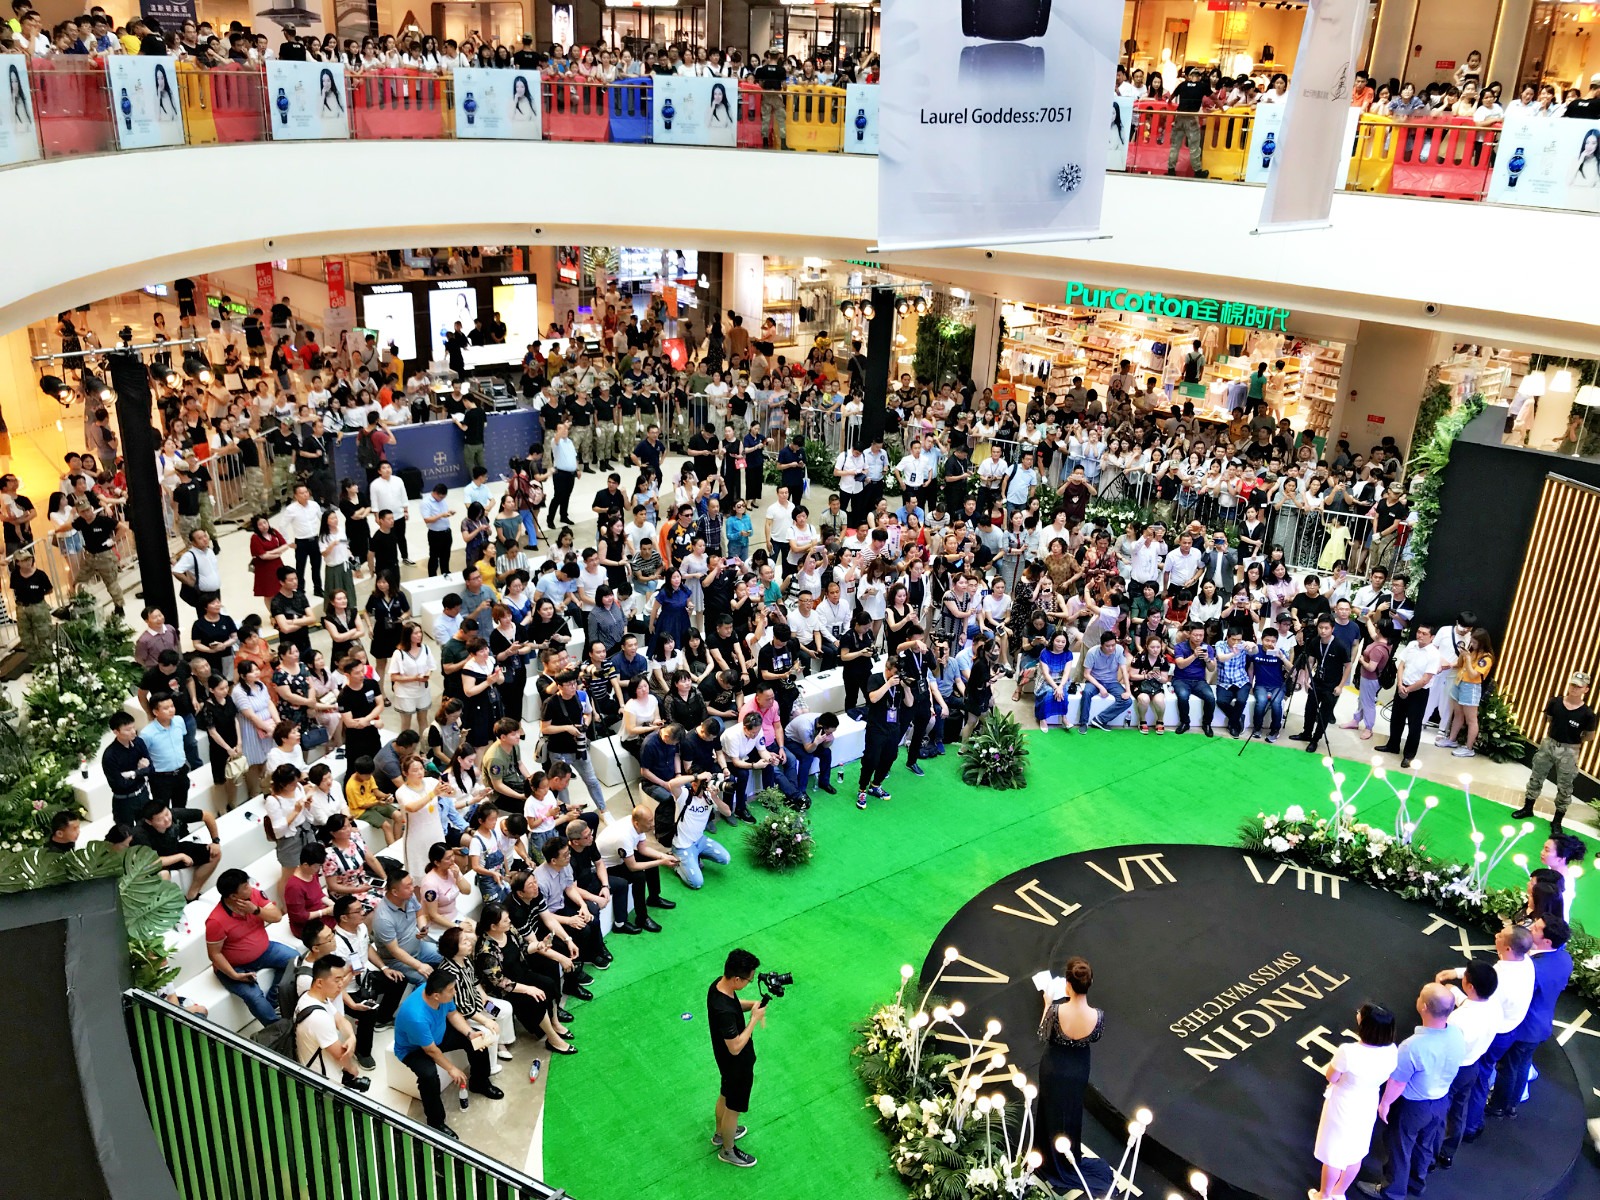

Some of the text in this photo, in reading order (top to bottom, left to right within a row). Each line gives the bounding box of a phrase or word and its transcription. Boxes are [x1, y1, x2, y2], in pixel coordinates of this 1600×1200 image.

[920, 107, 1072, 124] Laurel Goddess:7051
[258, 275, 273, 288] 618
[330, 296, 346, 308] 618
[1065, 281, 1290, 332] PurCotton 全棉时代
[422, 464, 460, 477] TANGIN
[992, 878, 1082, 926] VI
[1169, 951, 1301, 1038] SWISS WATCHES
[1183, 964, 1351, 1073] TANGIN
